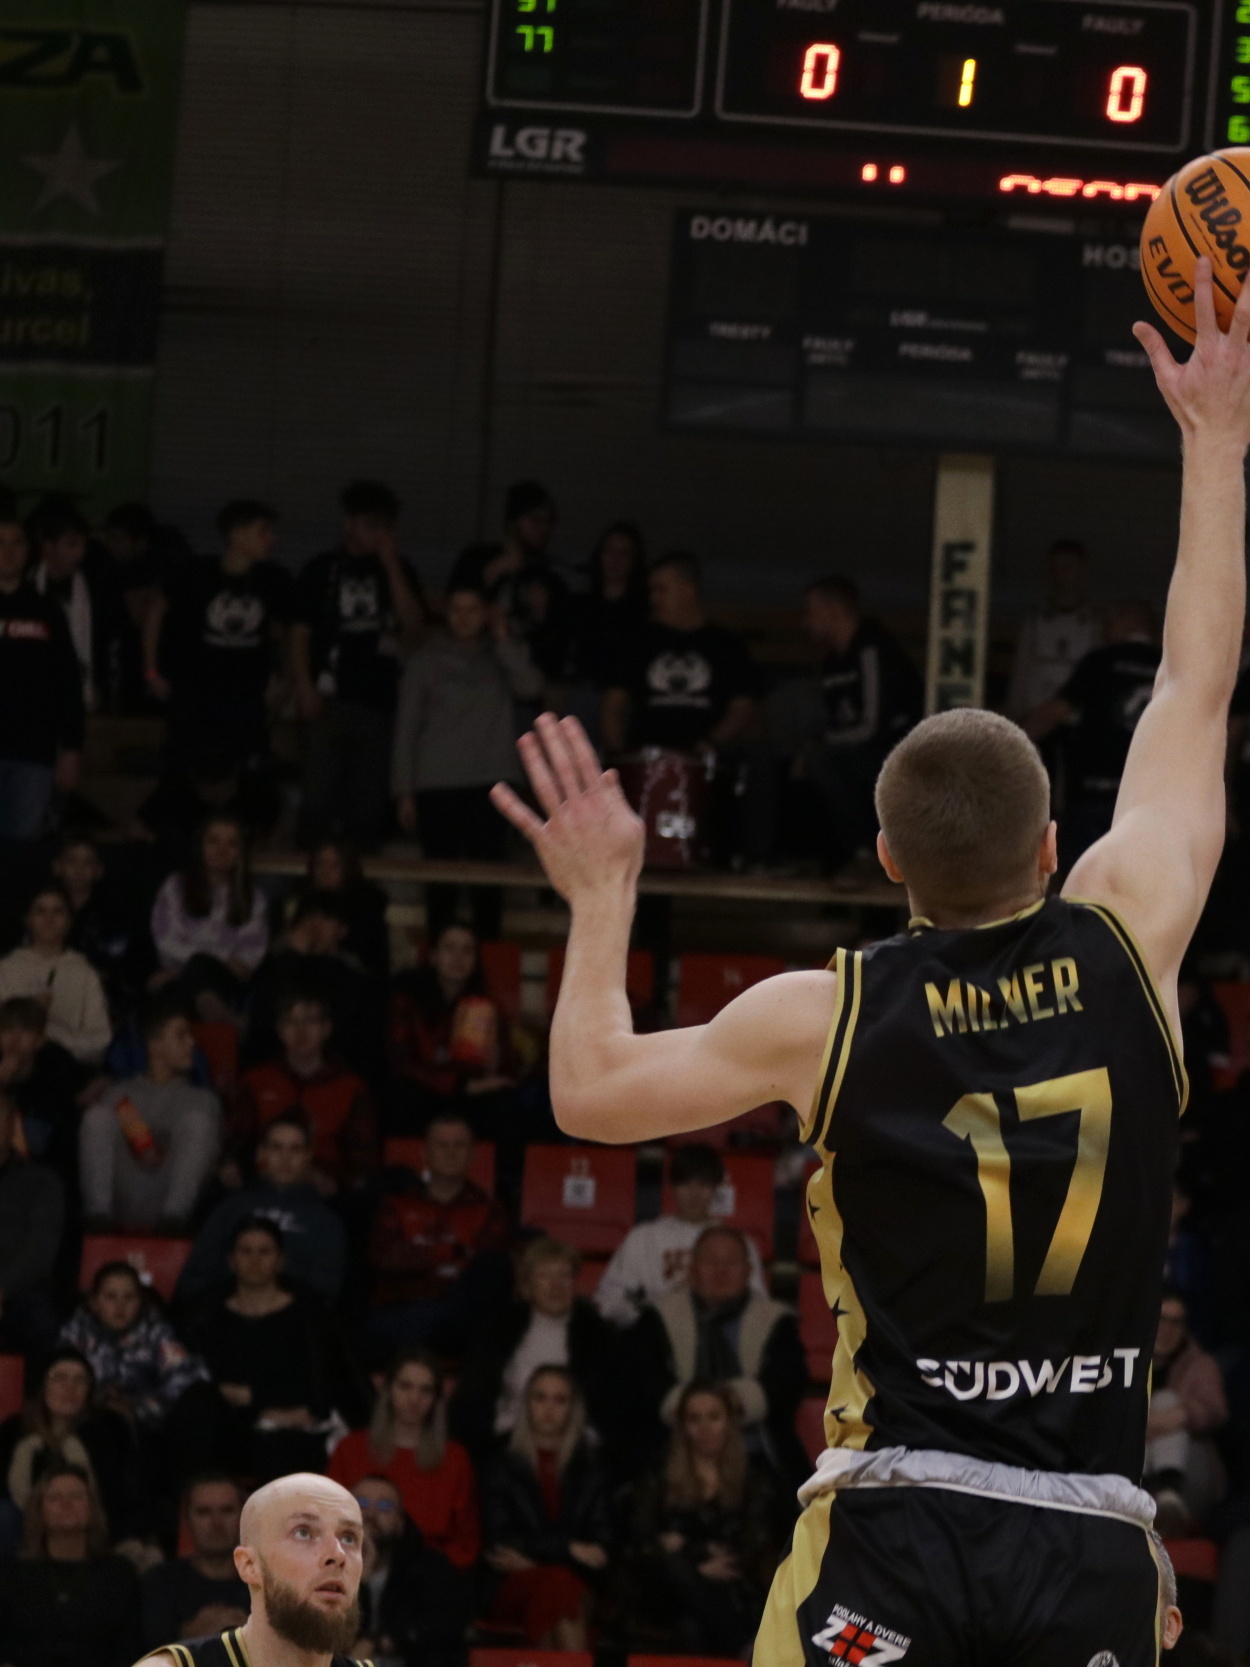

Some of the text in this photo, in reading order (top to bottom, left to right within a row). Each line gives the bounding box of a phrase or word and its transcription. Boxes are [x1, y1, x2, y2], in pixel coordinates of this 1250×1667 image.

[515, 25, 555, 53] 77
[801, 43, 840, 100] 0
[957, 58, 977, 107] 1
[1106, 66, 1147, 122] 0
[488, 123, 589, 164] LGR
[690, 215, 809, 246] DOMÁCI
[924, 956, 1084, 1038] MILNER
[941, 1066, 1113, 1302] 17
